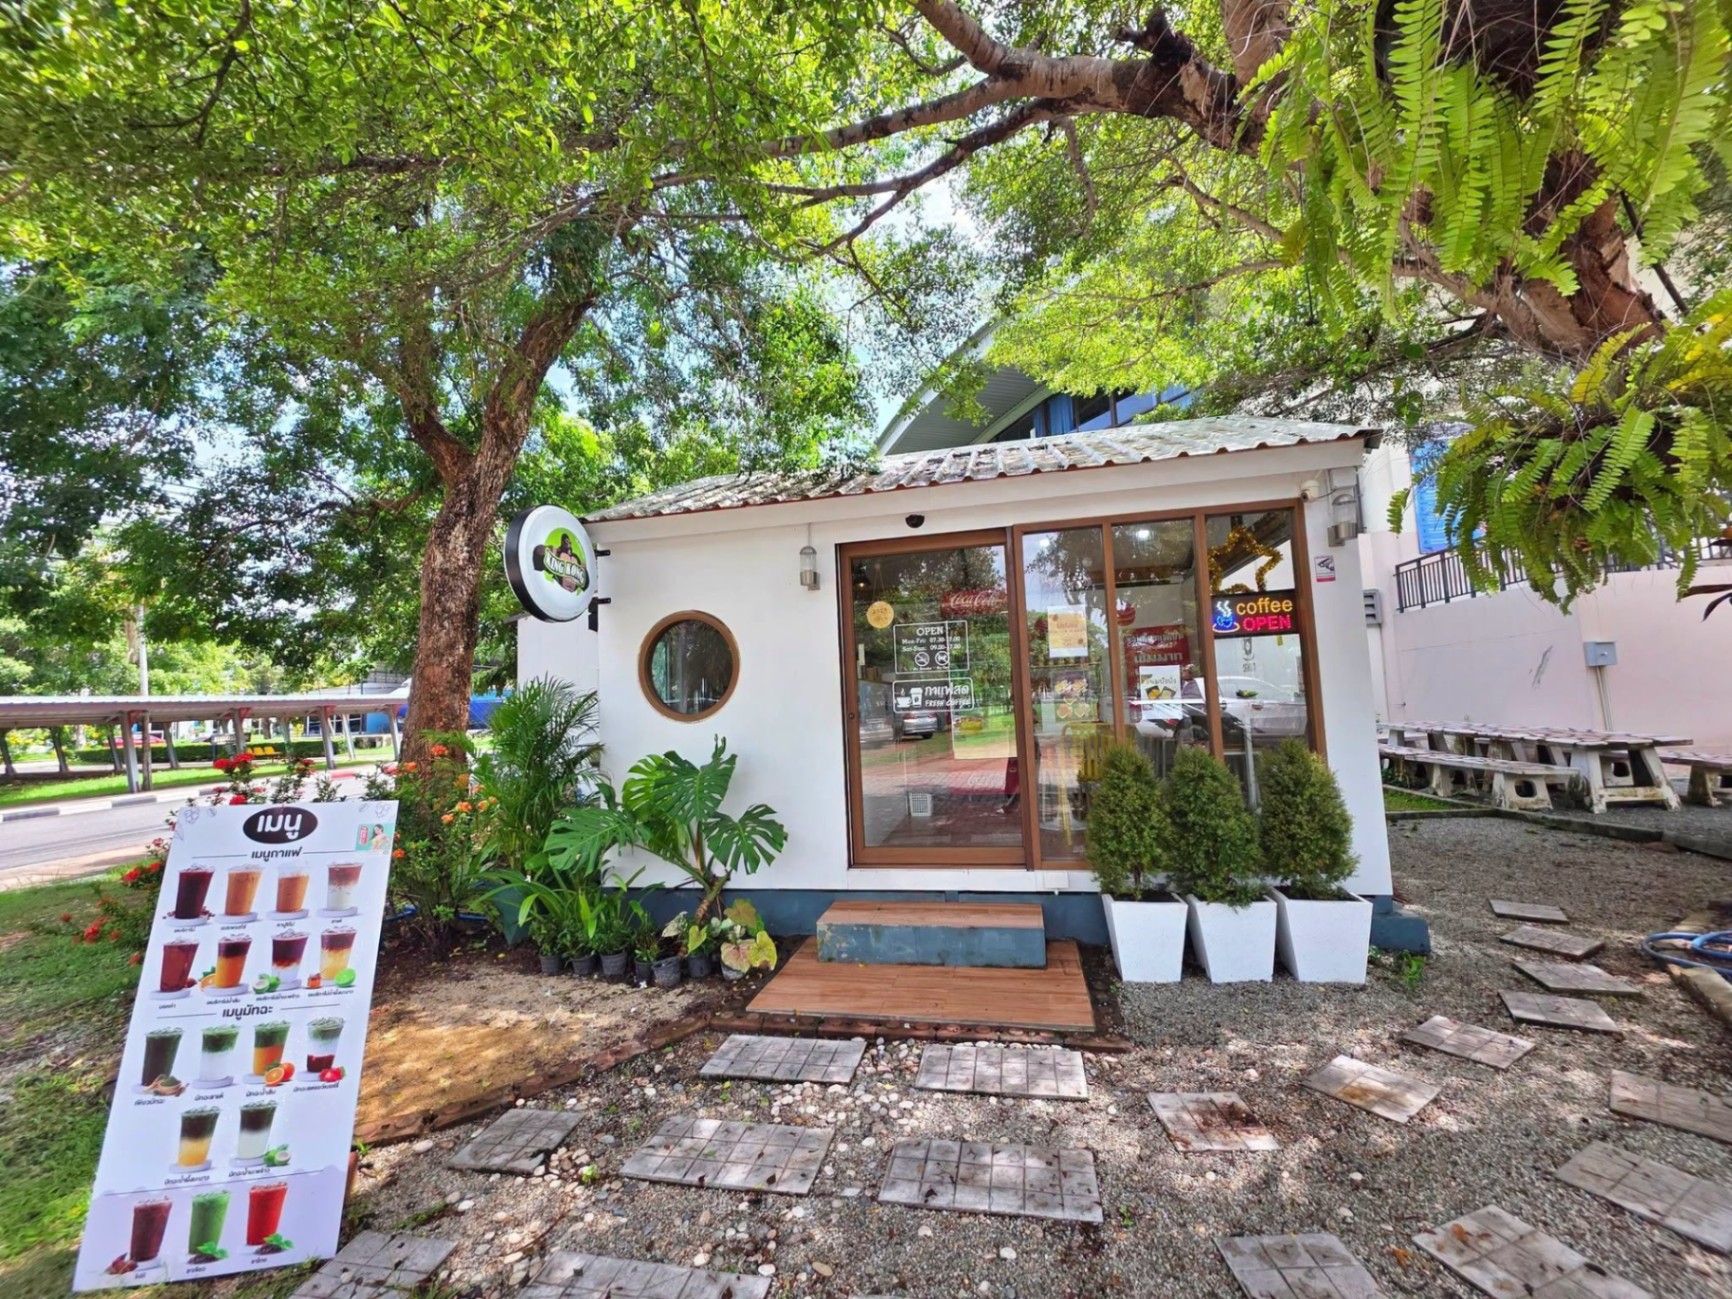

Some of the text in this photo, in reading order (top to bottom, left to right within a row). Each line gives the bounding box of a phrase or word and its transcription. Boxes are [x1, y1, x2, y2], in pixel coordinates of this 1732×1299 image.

[545, 555, 585, 584] KING KONG
[1236, 597, 1293, 615] coffee
[916, 626, 944, 636] OPEN
[1242, 614, 1292, 632] OPEN
[924, 682, 969, 697] กาแฟสด
[925, 699, 945, 707] FRESH
[257, 813, 302, 840] เมนู
[251, 846, 303, 862] เมนูกาแฟ
[222, 1004, 273, 1021] เมนูมัทฉะ
